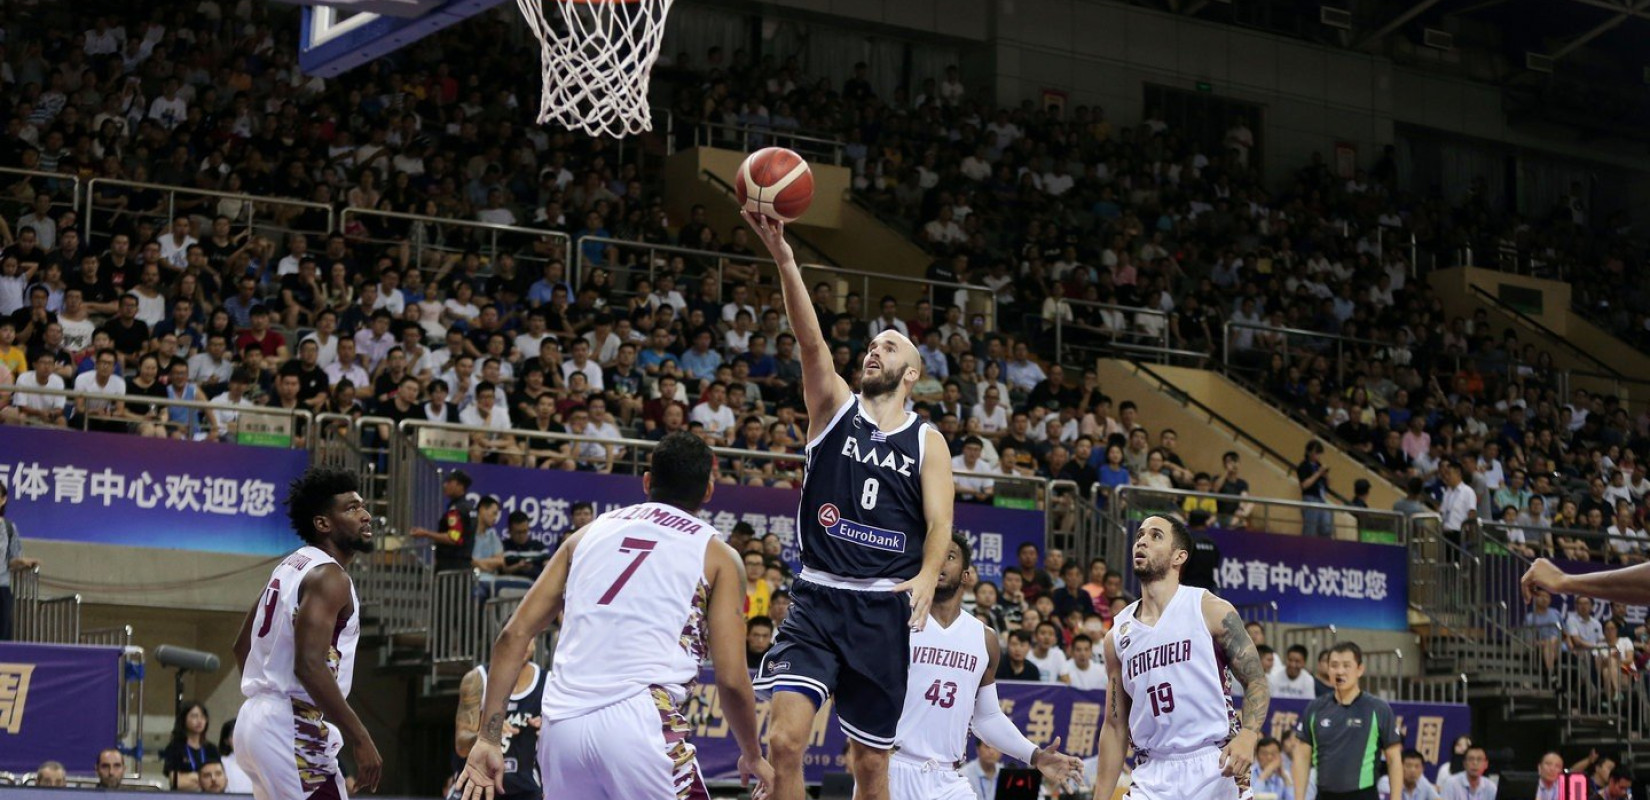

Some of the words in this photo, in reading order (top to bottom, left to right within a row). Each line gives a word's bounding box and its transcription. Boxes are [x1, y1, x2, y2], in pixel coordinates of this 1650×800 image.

[861, 478, 879, 510] 8
[839, 523, 900, 548] Eurobank
[596, 537, 658, 605] 7
[1213, 557, 1388, 600] 体育中心欢迎您
[912, 646, 978, 673] VENEZUELA
[1127, 639, 1191, 680] VENEZUELA
[924, 679, 957, 708] 43
[1147, 682, 1175, 717] 19
